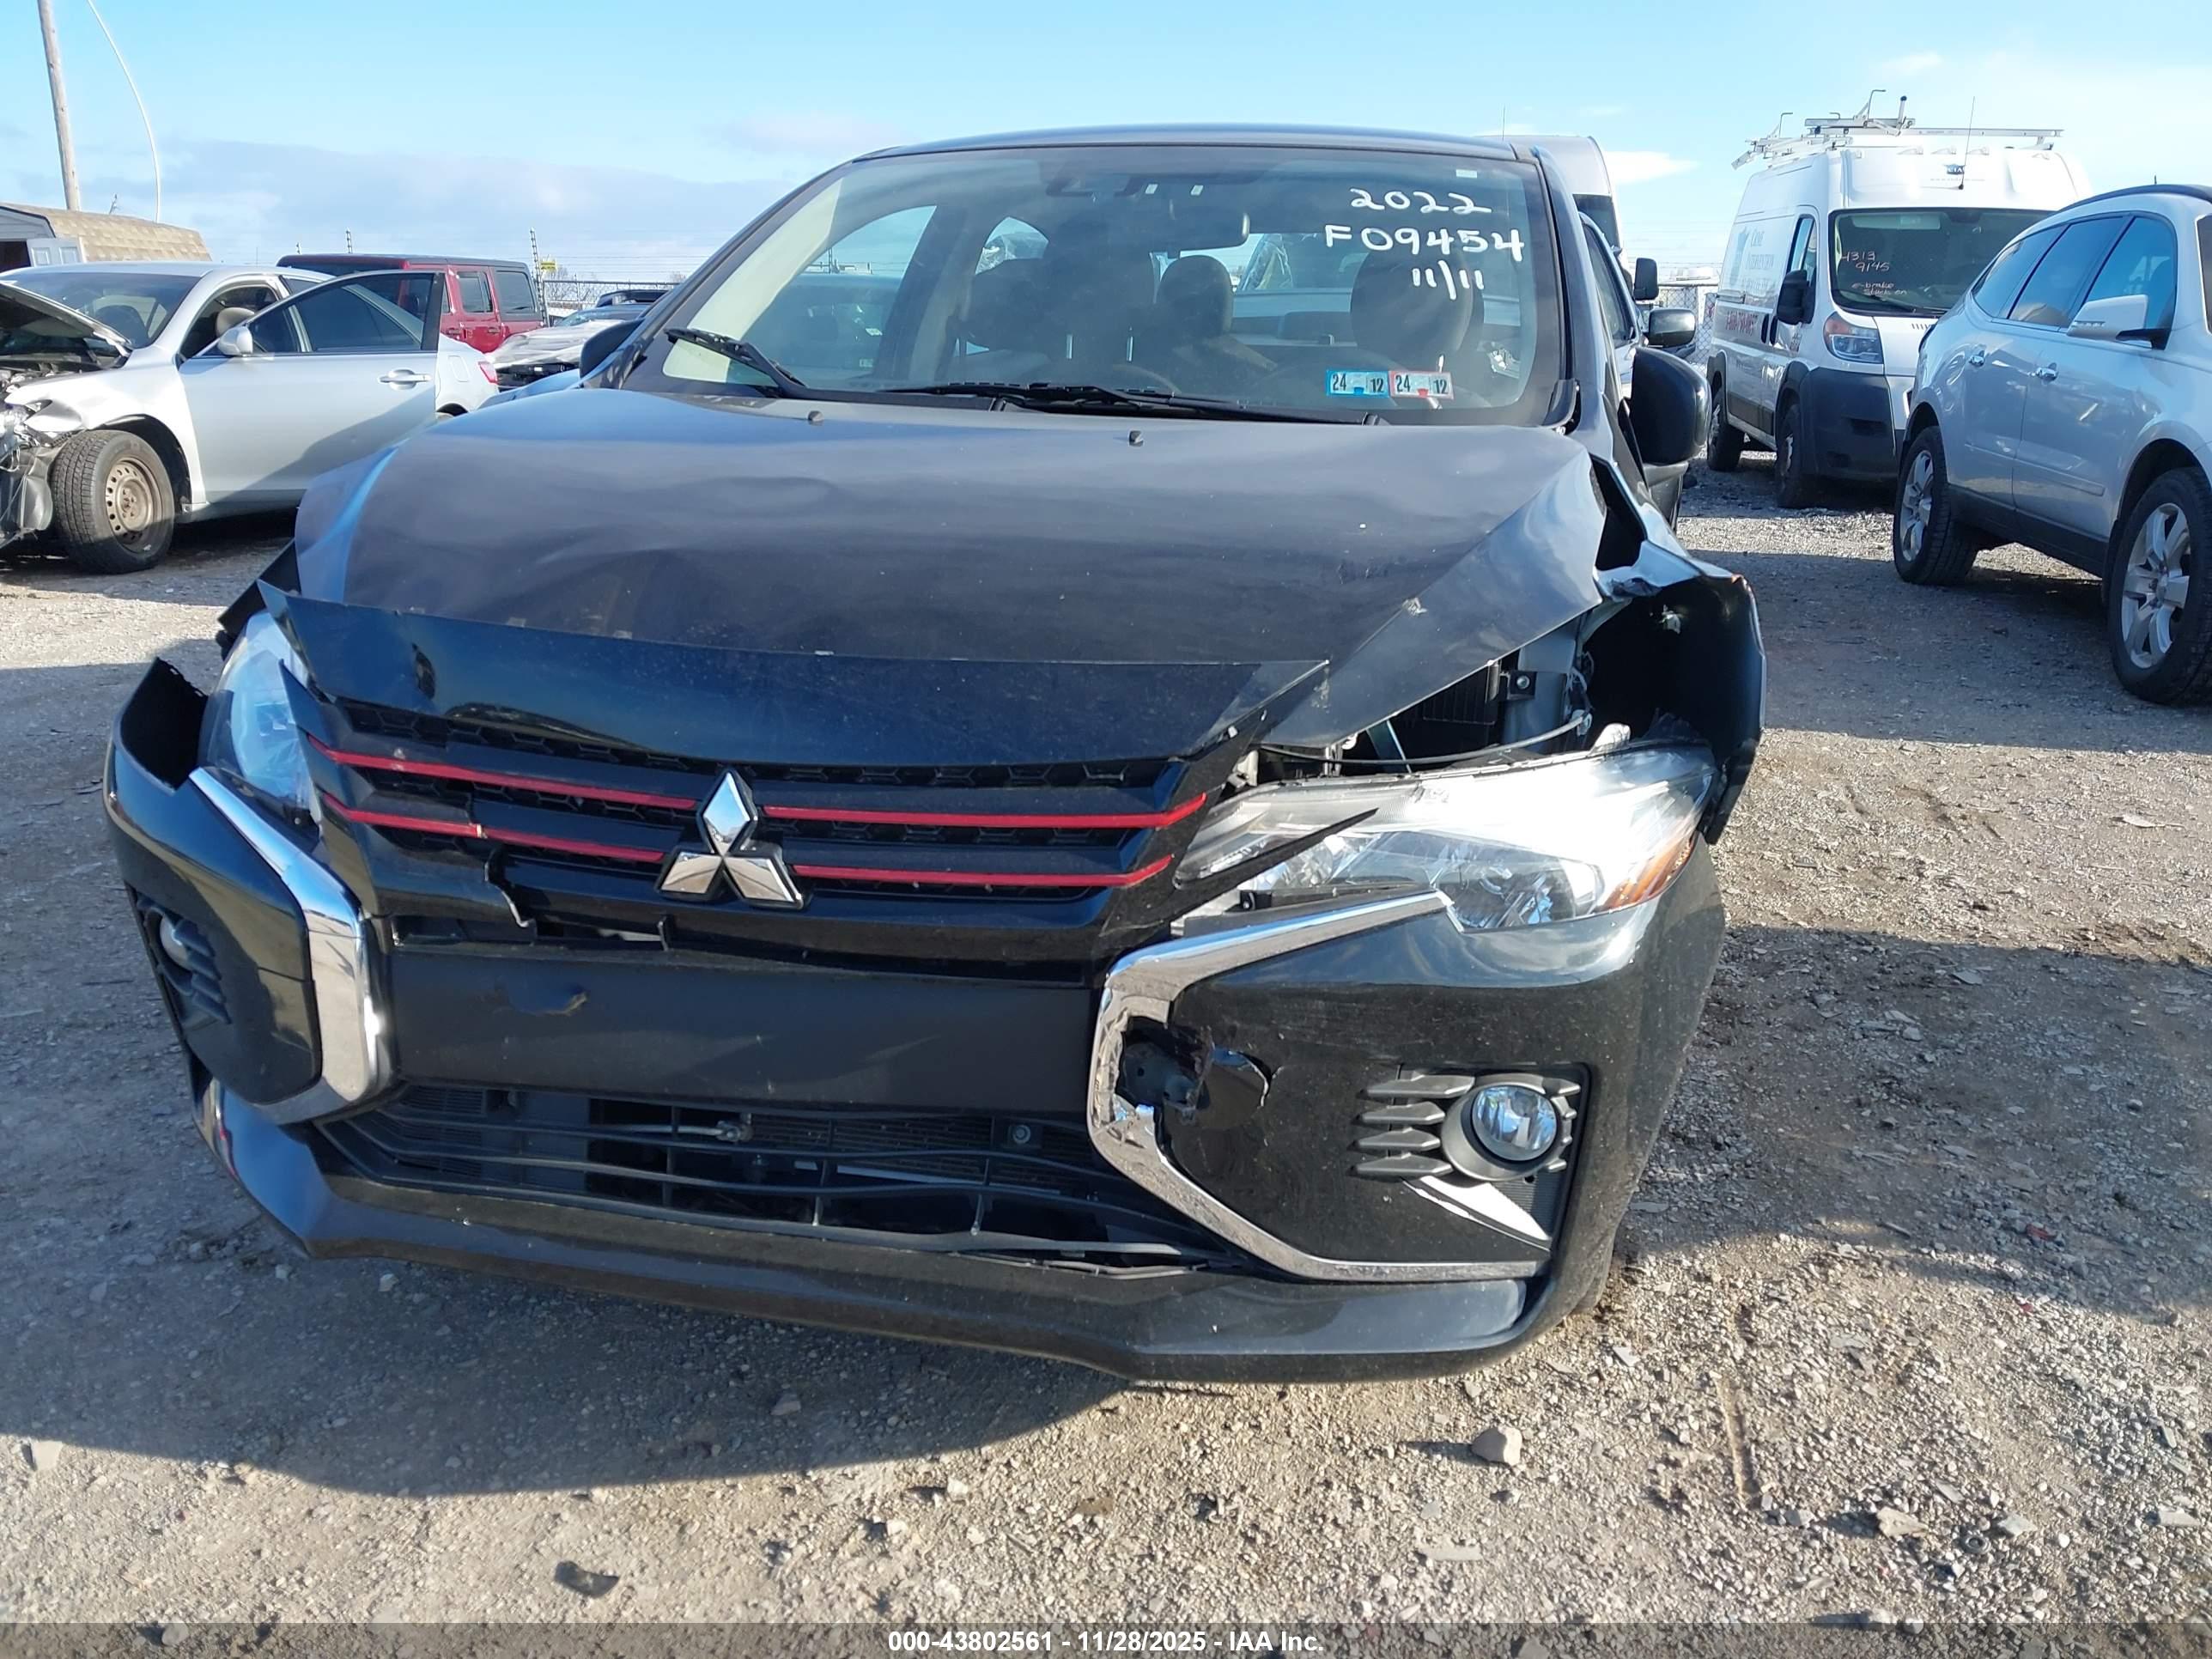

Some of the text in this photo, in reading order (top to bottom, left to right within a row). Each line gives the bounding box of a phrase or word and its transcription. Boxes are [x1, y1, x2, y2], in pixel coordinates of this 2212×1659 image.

[1349, 188, 1492, 214] 2022
[1324, 224, 1525, 262] F09454
[1332, 374, 1384, 393] 24 12
[1395, 375, 1448, 395] 24 12
